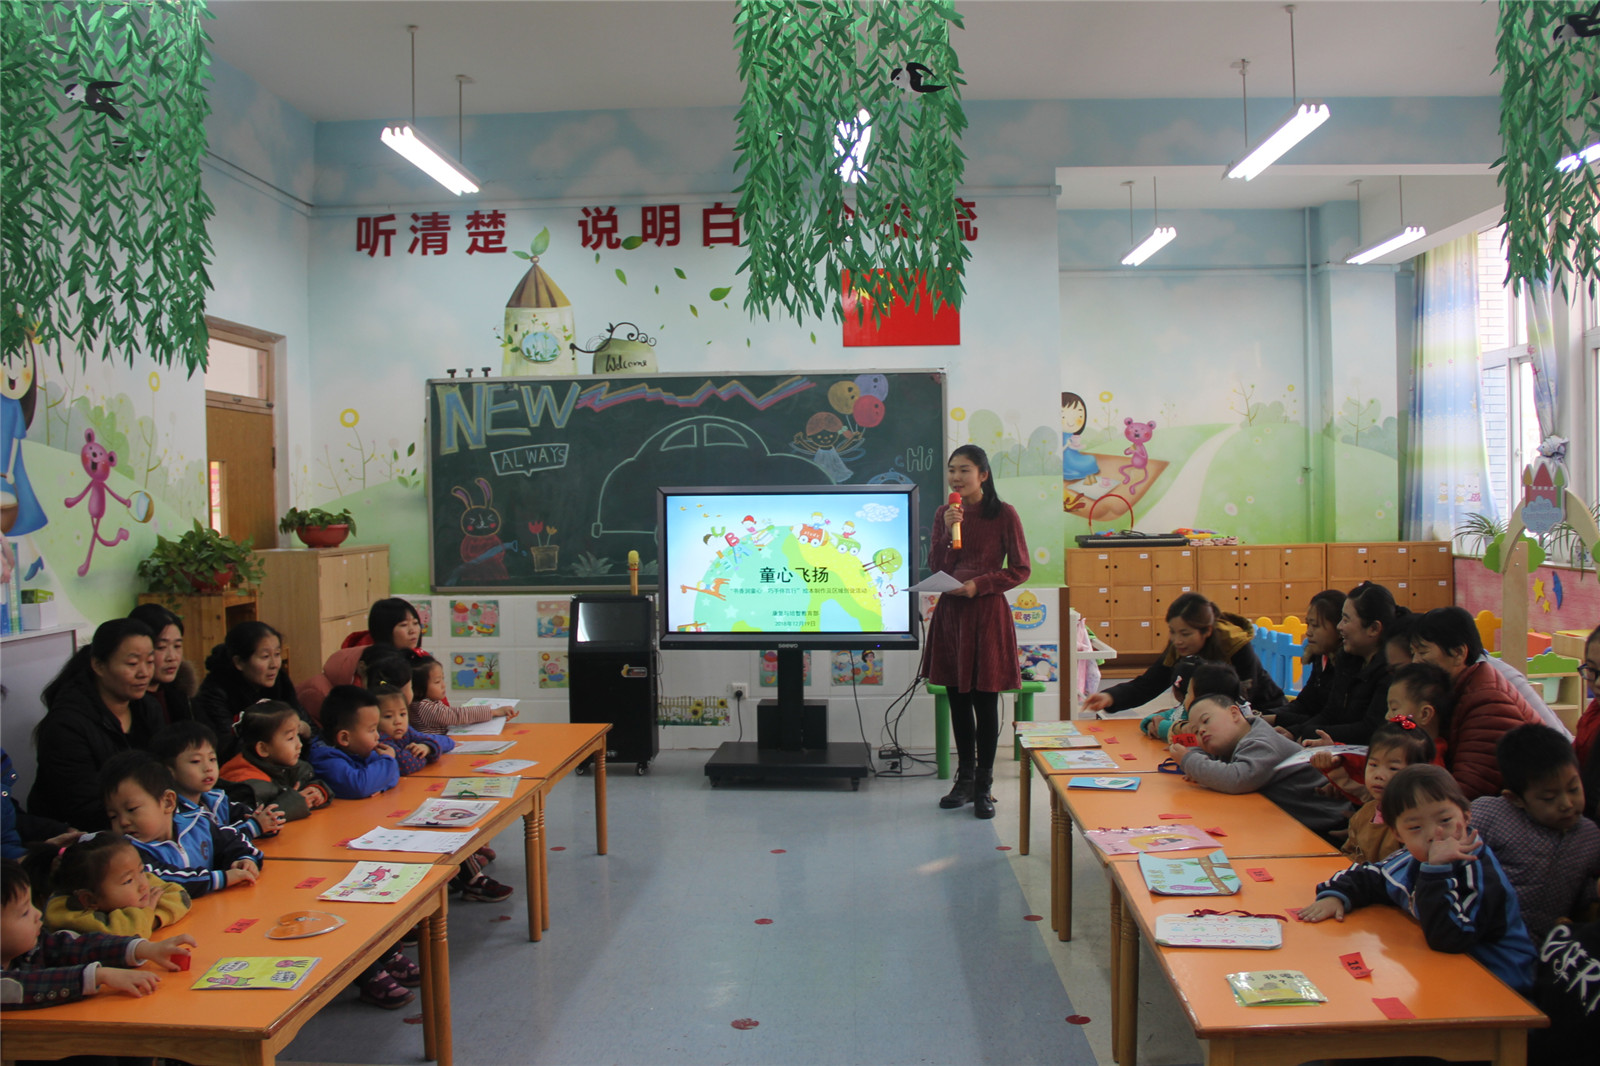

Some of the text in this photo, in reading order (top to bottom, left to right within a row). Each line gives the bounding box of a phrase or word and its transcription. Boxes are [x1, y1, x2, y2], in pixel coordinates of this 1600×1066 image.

[356, 202, 741, 258] 听清楚 说明白
[605, 354, 648, 372] Welcome
[435, 381, 581, 456] NEW
[501, 446, 566, 470] ALWAYS
[759, 566, 829, 584] 童心飞扬
